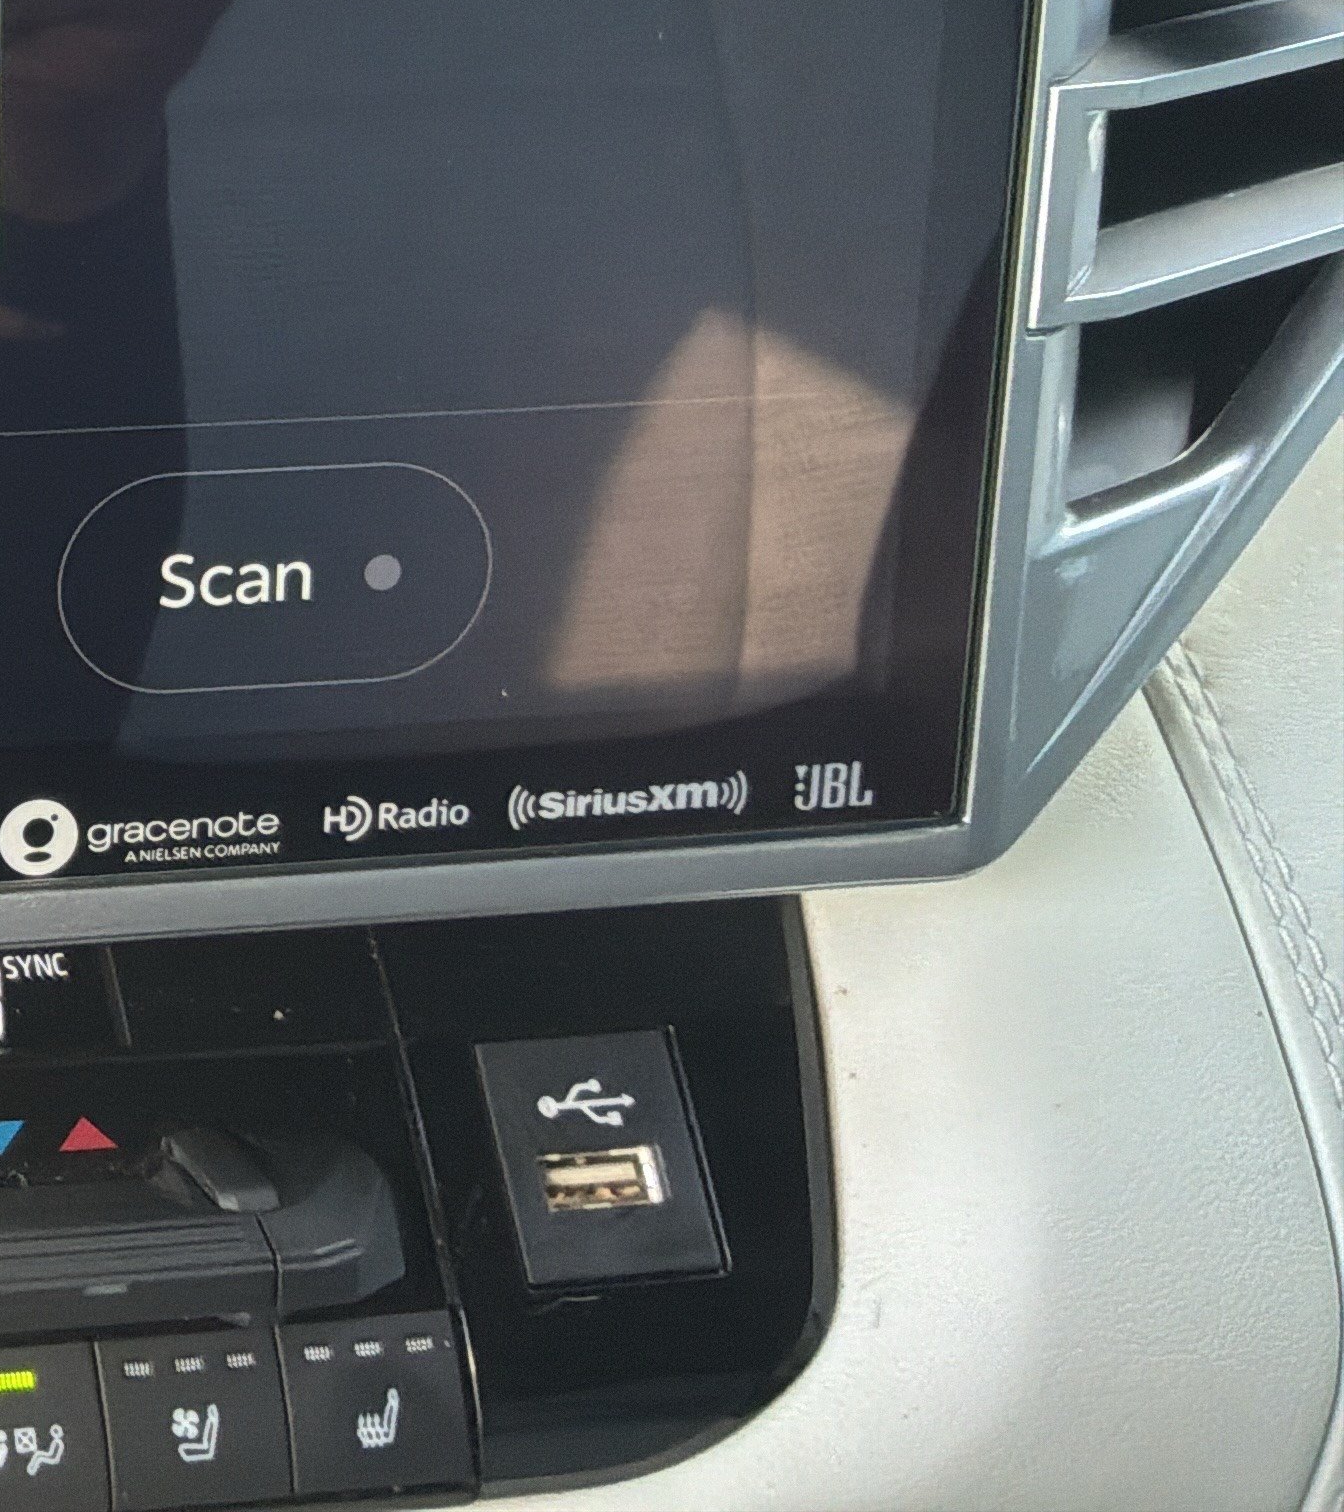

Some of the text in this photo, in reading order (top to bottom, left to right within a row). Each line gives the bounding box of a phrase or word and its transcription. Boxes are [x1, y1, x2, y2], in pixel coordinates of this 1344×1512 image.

[159, 553, 312, 609] Scan
[794, 760, 874, 811] JBL
[86, 811, 280, 853] gracenote
[378, 798, 470, 830] Radio
[123, 841, 281, 864] A NIELSEN COMPANY
[1, 952, 69, 980] SYNC
